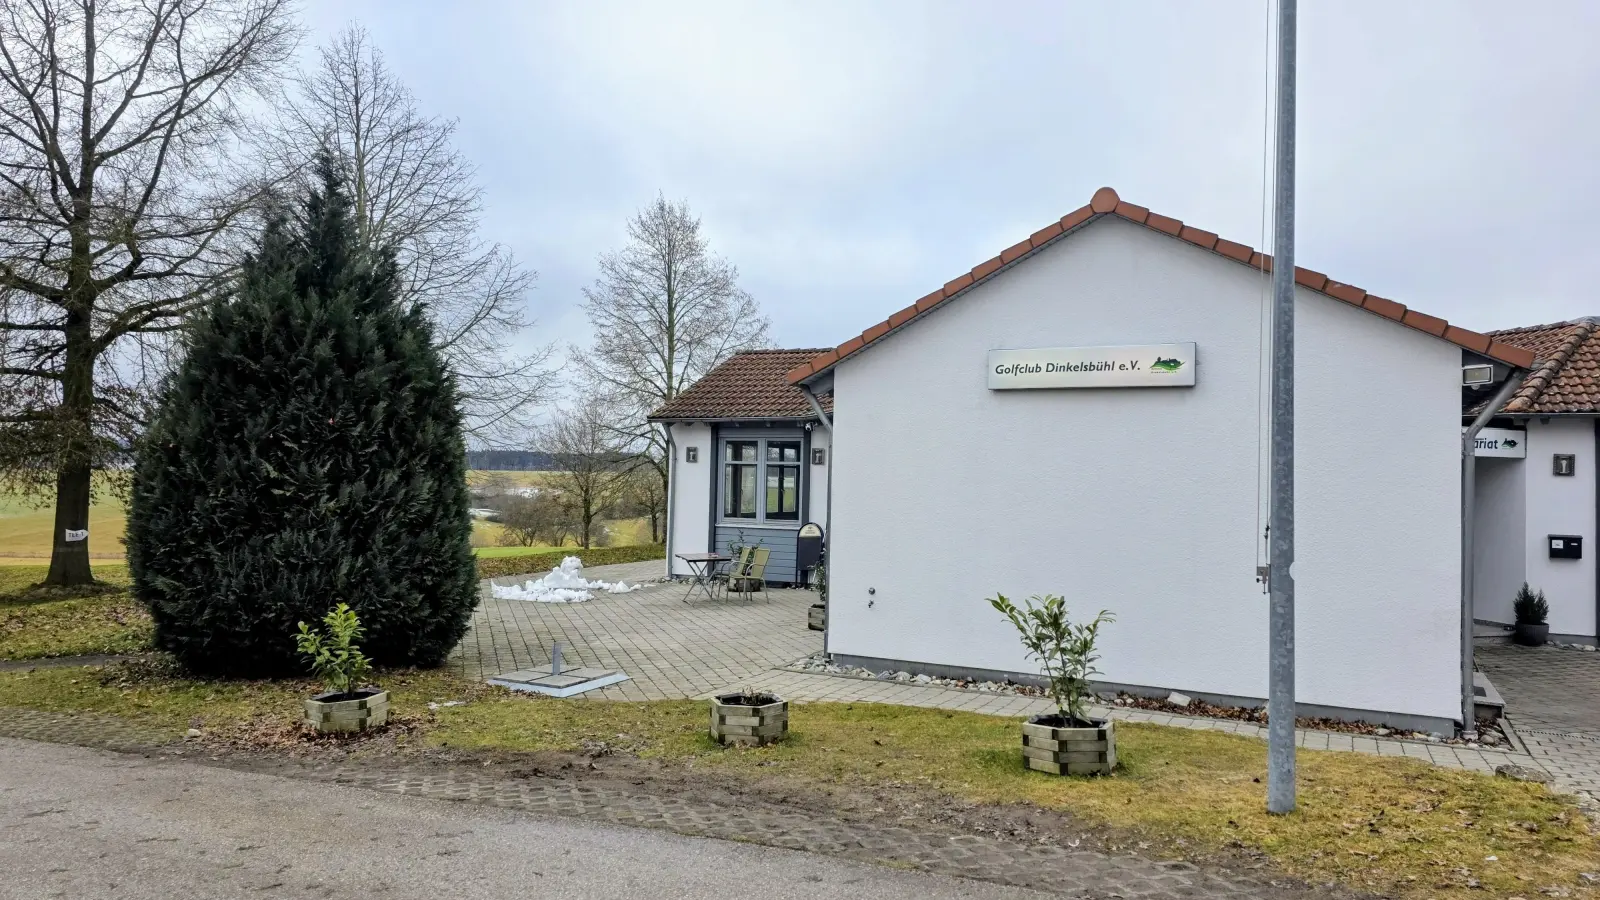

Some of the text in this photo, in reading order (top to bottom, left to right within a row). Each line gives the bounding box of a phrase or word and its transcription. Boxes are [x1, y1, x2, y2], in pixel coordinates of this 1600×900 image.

[995, 360, 1140, 376] Golfclub Dinkelsbühl e.V.
